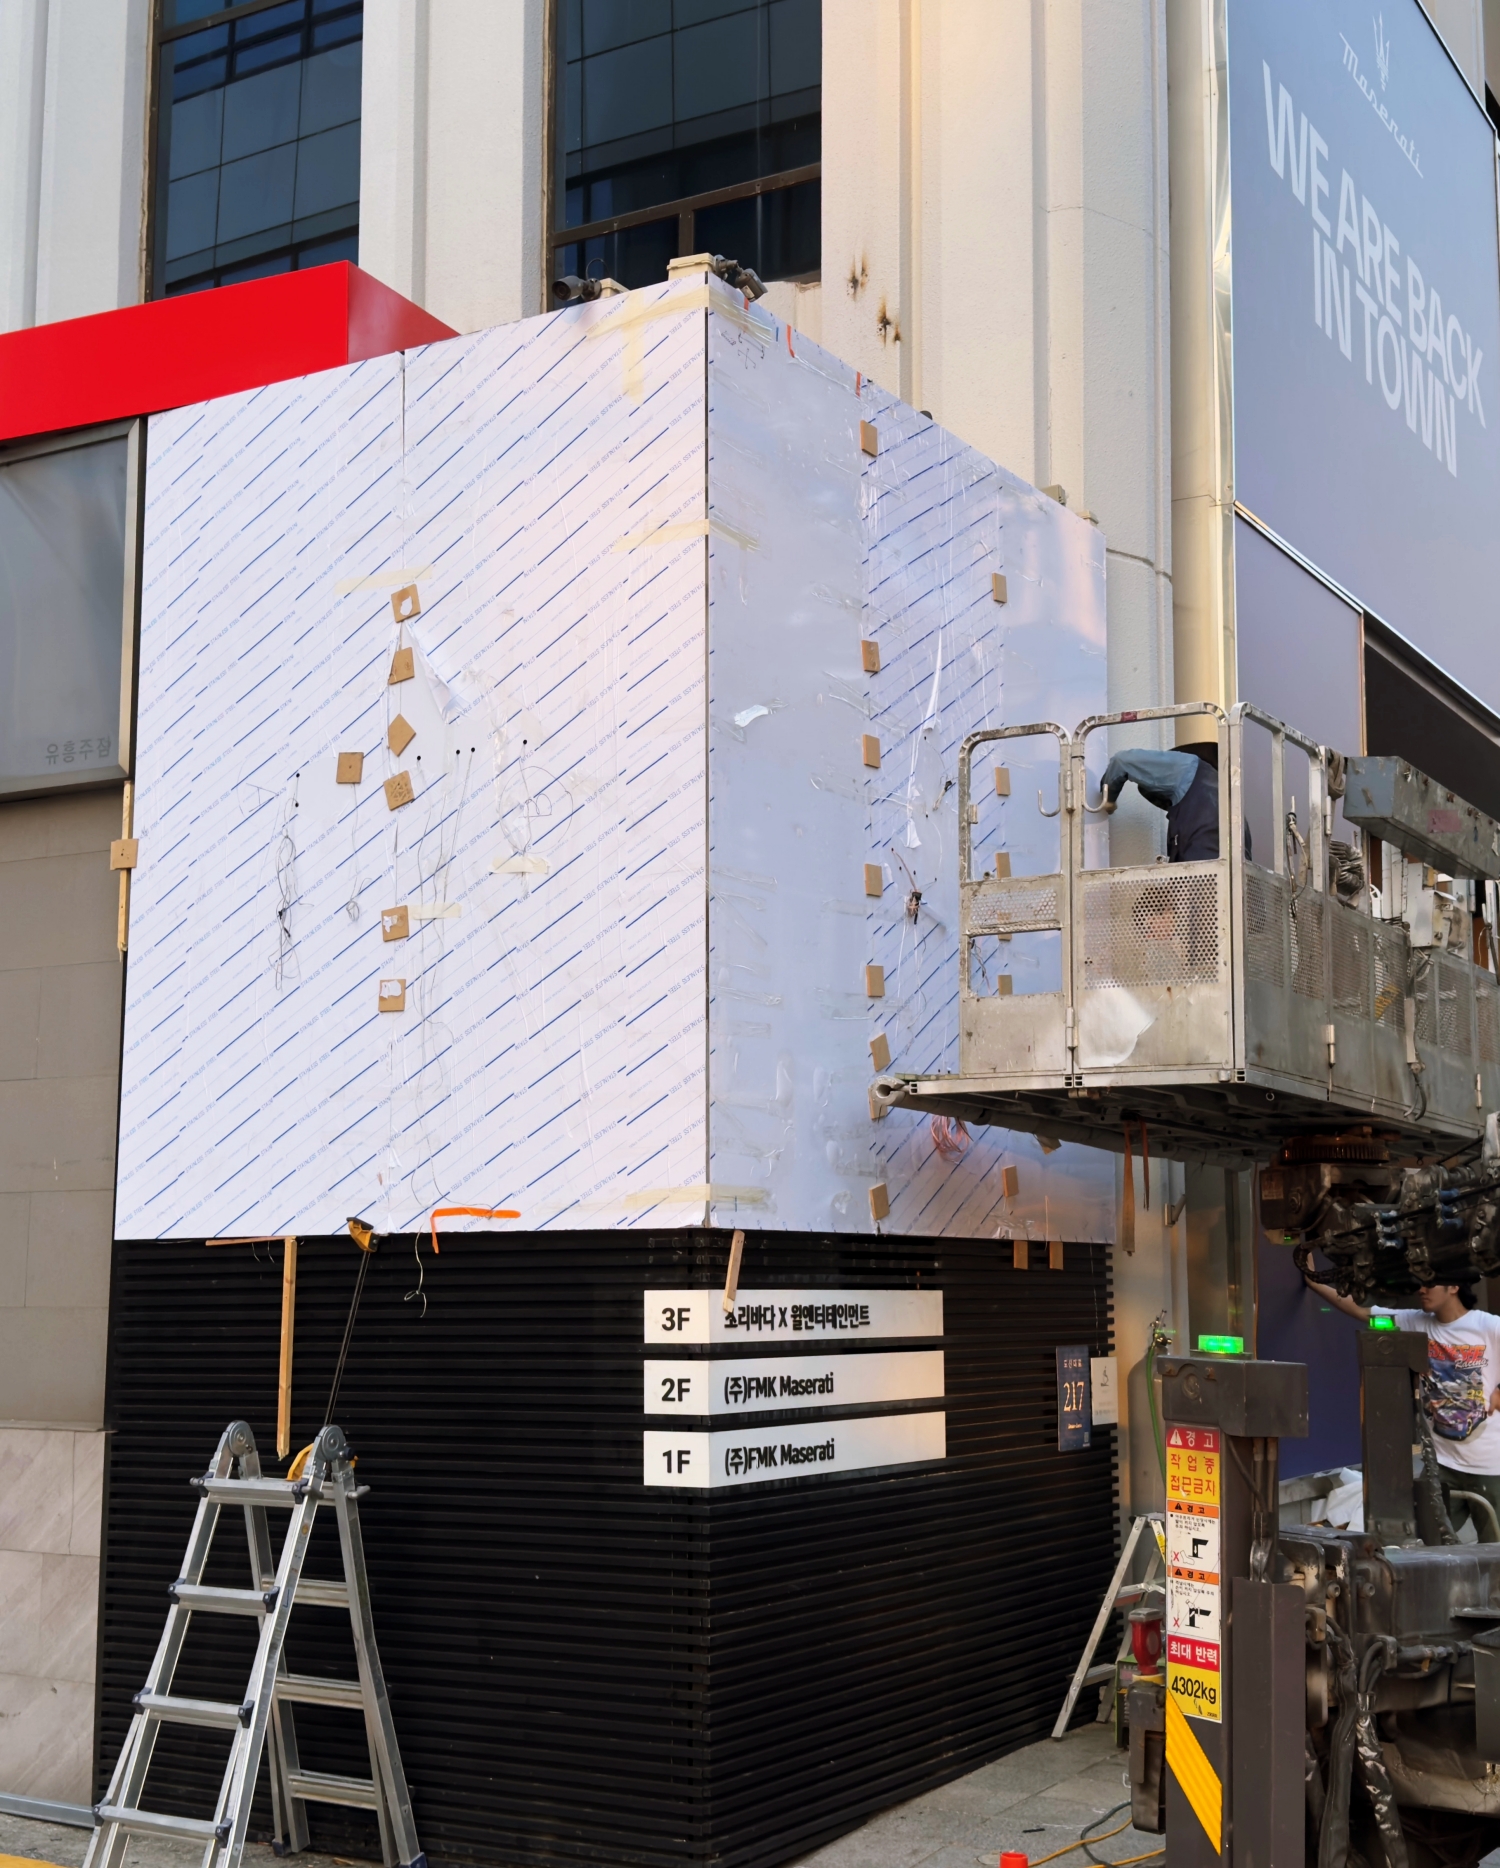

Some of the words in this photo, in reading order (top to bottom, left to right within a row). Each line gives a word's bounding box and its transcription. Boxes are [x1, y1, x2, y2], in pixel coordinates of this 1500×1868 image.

[1340, 33, 1424, 178] Maserati
[1263, 60, 1331, 238] WE
[1337, 168, 1402, 326] ARE
[1407, 255, 1486, 429] BACK
[1313, 228, 1352, 361] IN
[1355, 280, 1457, 478] TOWN
[45, 736, 112, 765] 유흥주점
[661, 1307, 691, 1331] 3F
[724, 1305, 775, 1331] 소리바다
[778, 1307, 788, 1328] X
[791, 1304, 870, 1331] 월엔터테인먼트
[661, 1378, 691, 1402] 2F
[724, 1376, 777, 1404] (주)FMK
[780, 1372, 834, 1397] Maserati
[1063, 1381, 1084, 1412] 217
[662, 1450, 691, 1474] 1F
[725, 1445, 777, 1476] (주)FMK
[781, 1438, 835, 1465] Maserati
[1170, 1641, 1191, 1660] 최대
[1195, 1646, 1217, 1665] 반력
[1171, 1676, 1217, 1705] 4302kg
